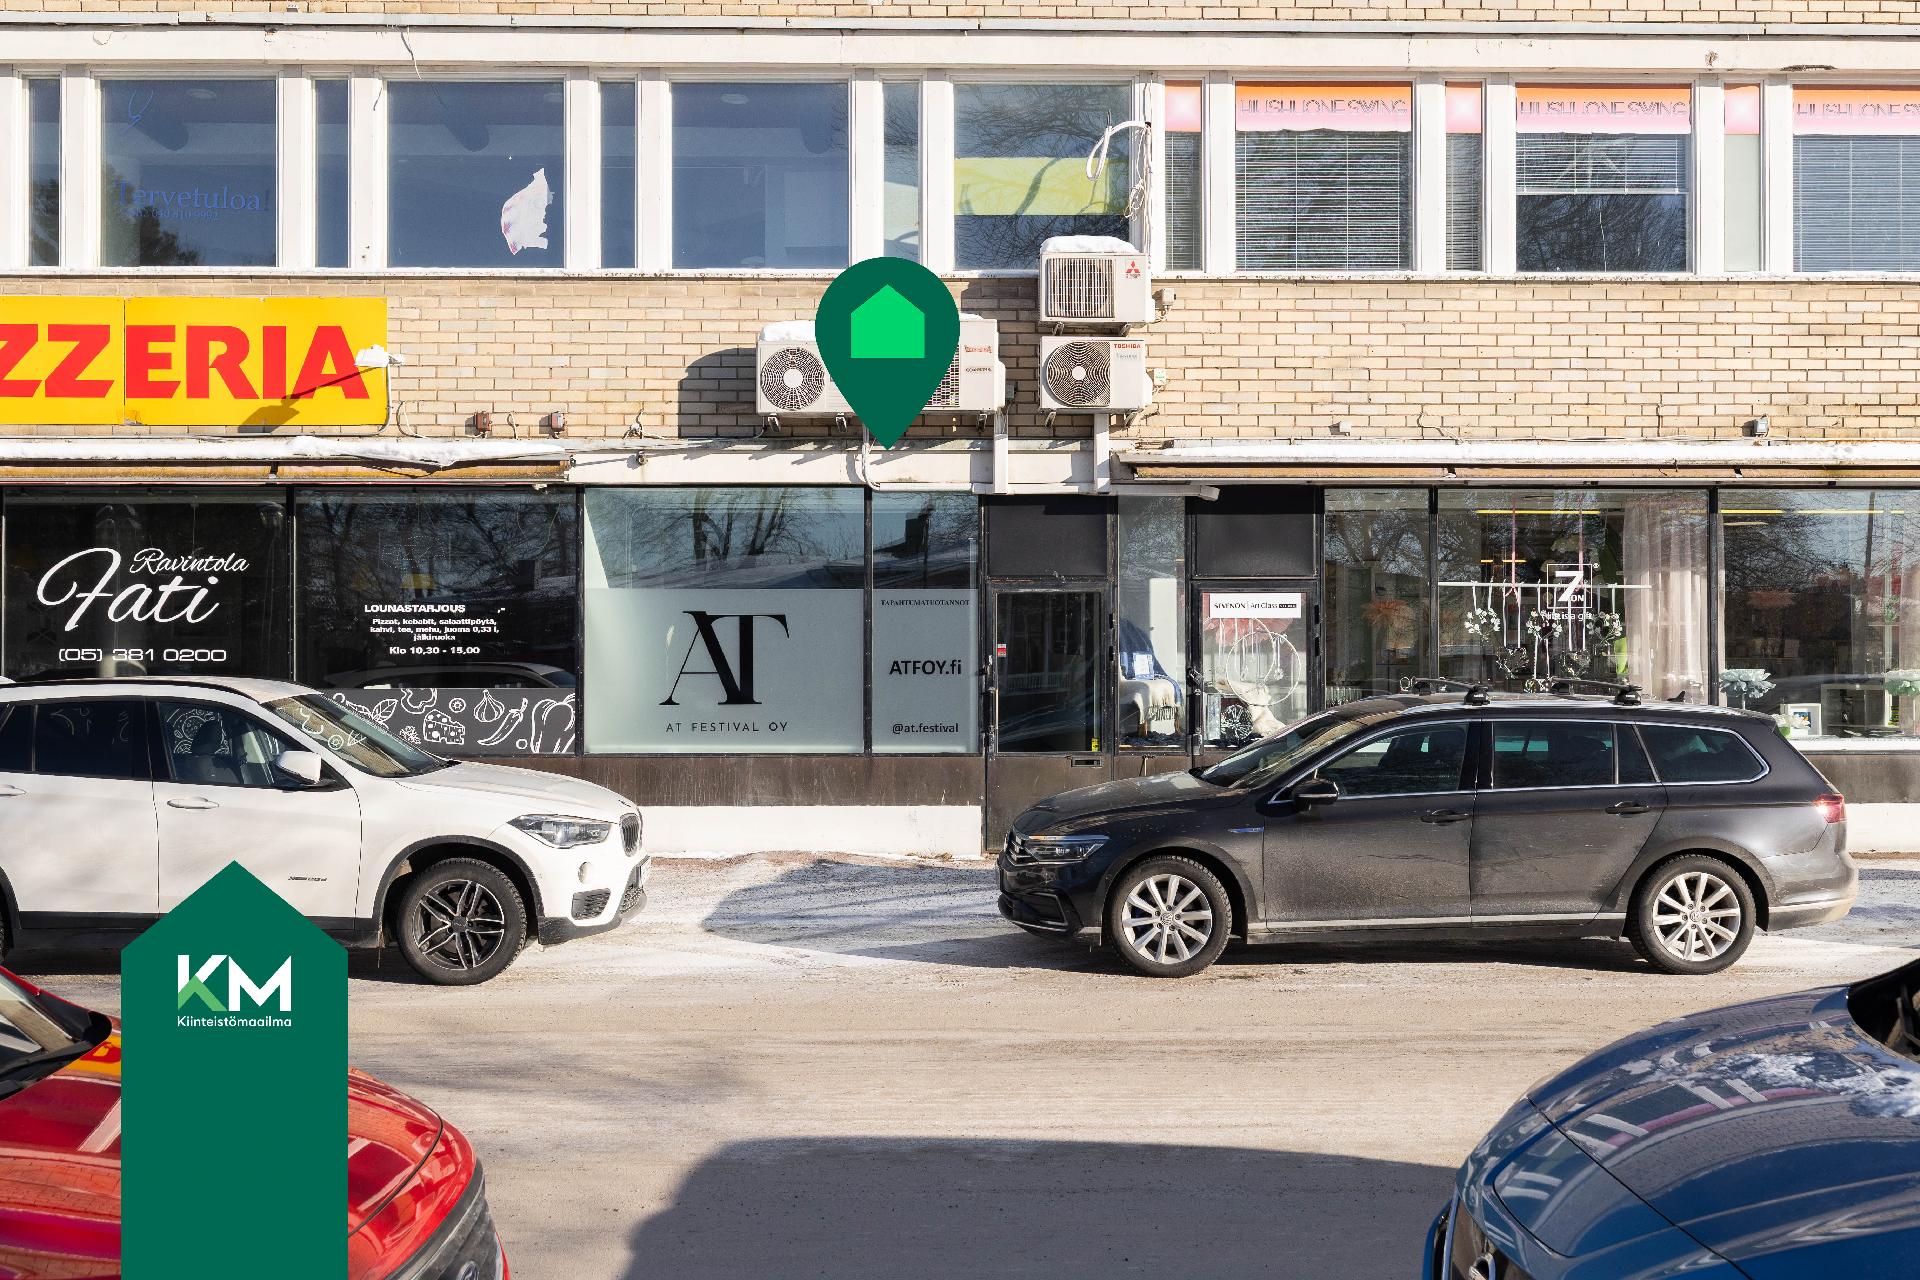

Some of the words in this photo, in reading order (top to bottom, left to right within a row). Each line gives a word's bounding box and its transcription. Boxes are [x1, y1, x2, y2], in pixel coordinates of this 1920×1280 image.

[1348, 100, 1407, 114] SWING
[1627, 102, 1687, 116] SWING
[130, 548, 249, 574] Ravintola
[37, 547, 220, 632] Fati
[364, 604, 466, 613] LOUNASTARJOUS
[416, 626, 442, 634] mehu,
[58, 648, 103, 662] (05)
[112, 648, 154, 661] 381
[163, 649, 227, 661] 0200
[409, 647, 440, 655] 10,30
[450, 647, 481, 655] 15,00
[659, 611, 790, 705] AT
[889, 660, 962, 675] ATFOY.fi
[666, 722, 682, 732] AT
[692, 722, 760, 732] FESTIVAL
[768, 722, 788, 732] OY
[892, 722, 959, 735] @at.festival
